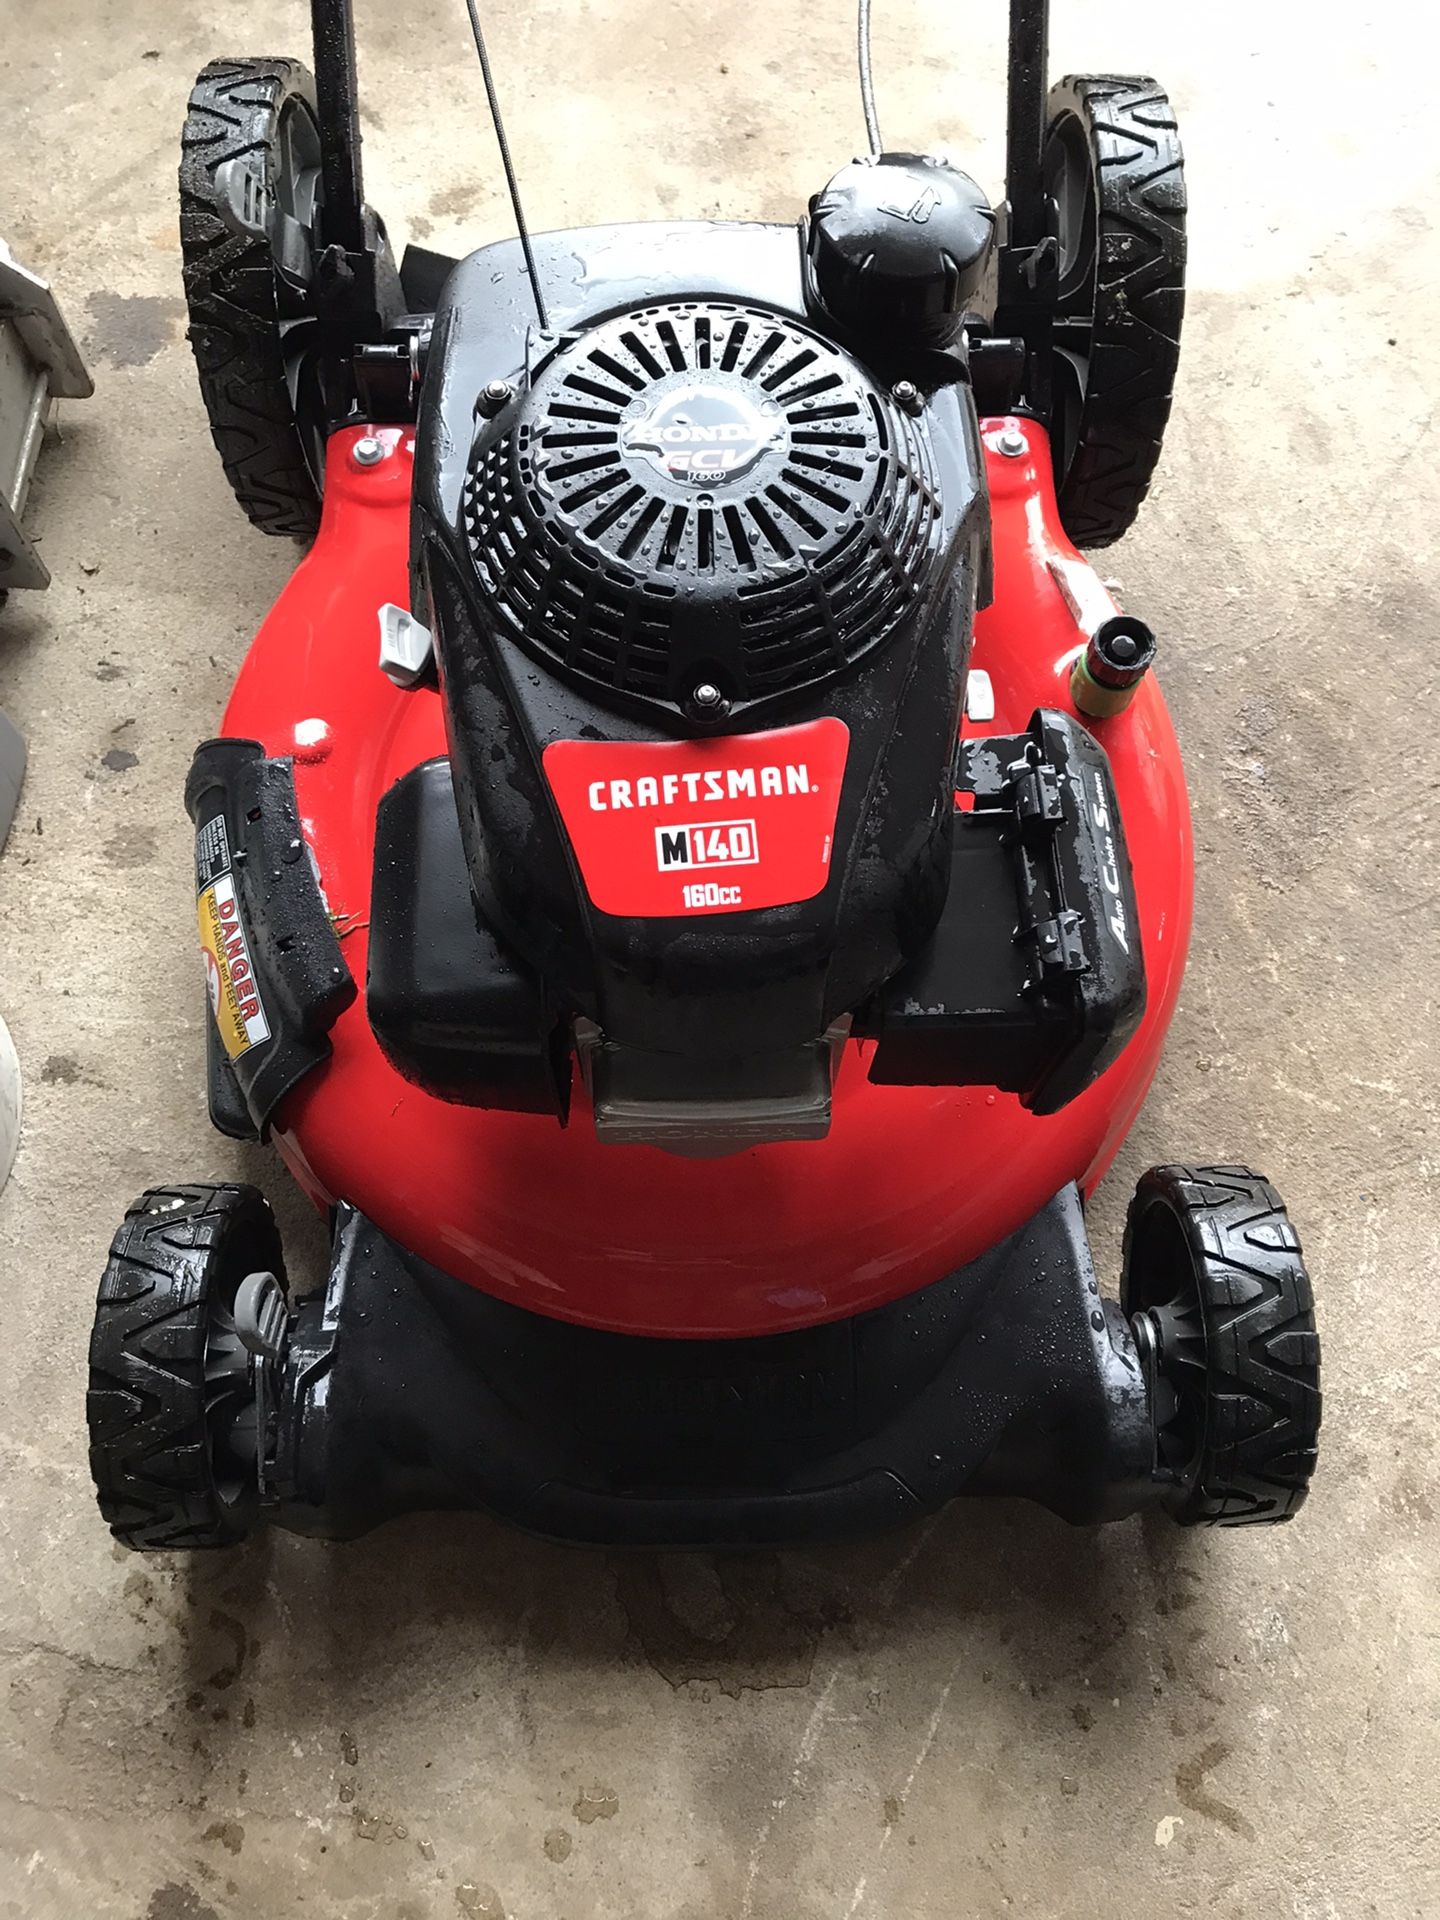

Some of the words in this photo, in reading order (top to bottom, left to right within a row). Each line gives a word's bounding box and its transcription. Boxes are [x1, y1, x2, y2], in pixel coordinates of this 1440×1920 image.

[633, 423, 768, 443] HOND
[688, 469, 725, 481] 160
[1093, 772, 1110, 832] System
[660, 826, 753, 865] M140
[1103, 836, 1120, 894] Choke
[206, 893, 219, 922] KEEP
[211, 921, 225, 962] HANDS
[1110, 899, 1129, 955] Auto
[218, 897, 260, 1022] DANGER
[220, 962, 228, 982] and
[223, 982, 237, 1011] FEET
[231, 1011, 249, 1045] AWAY
